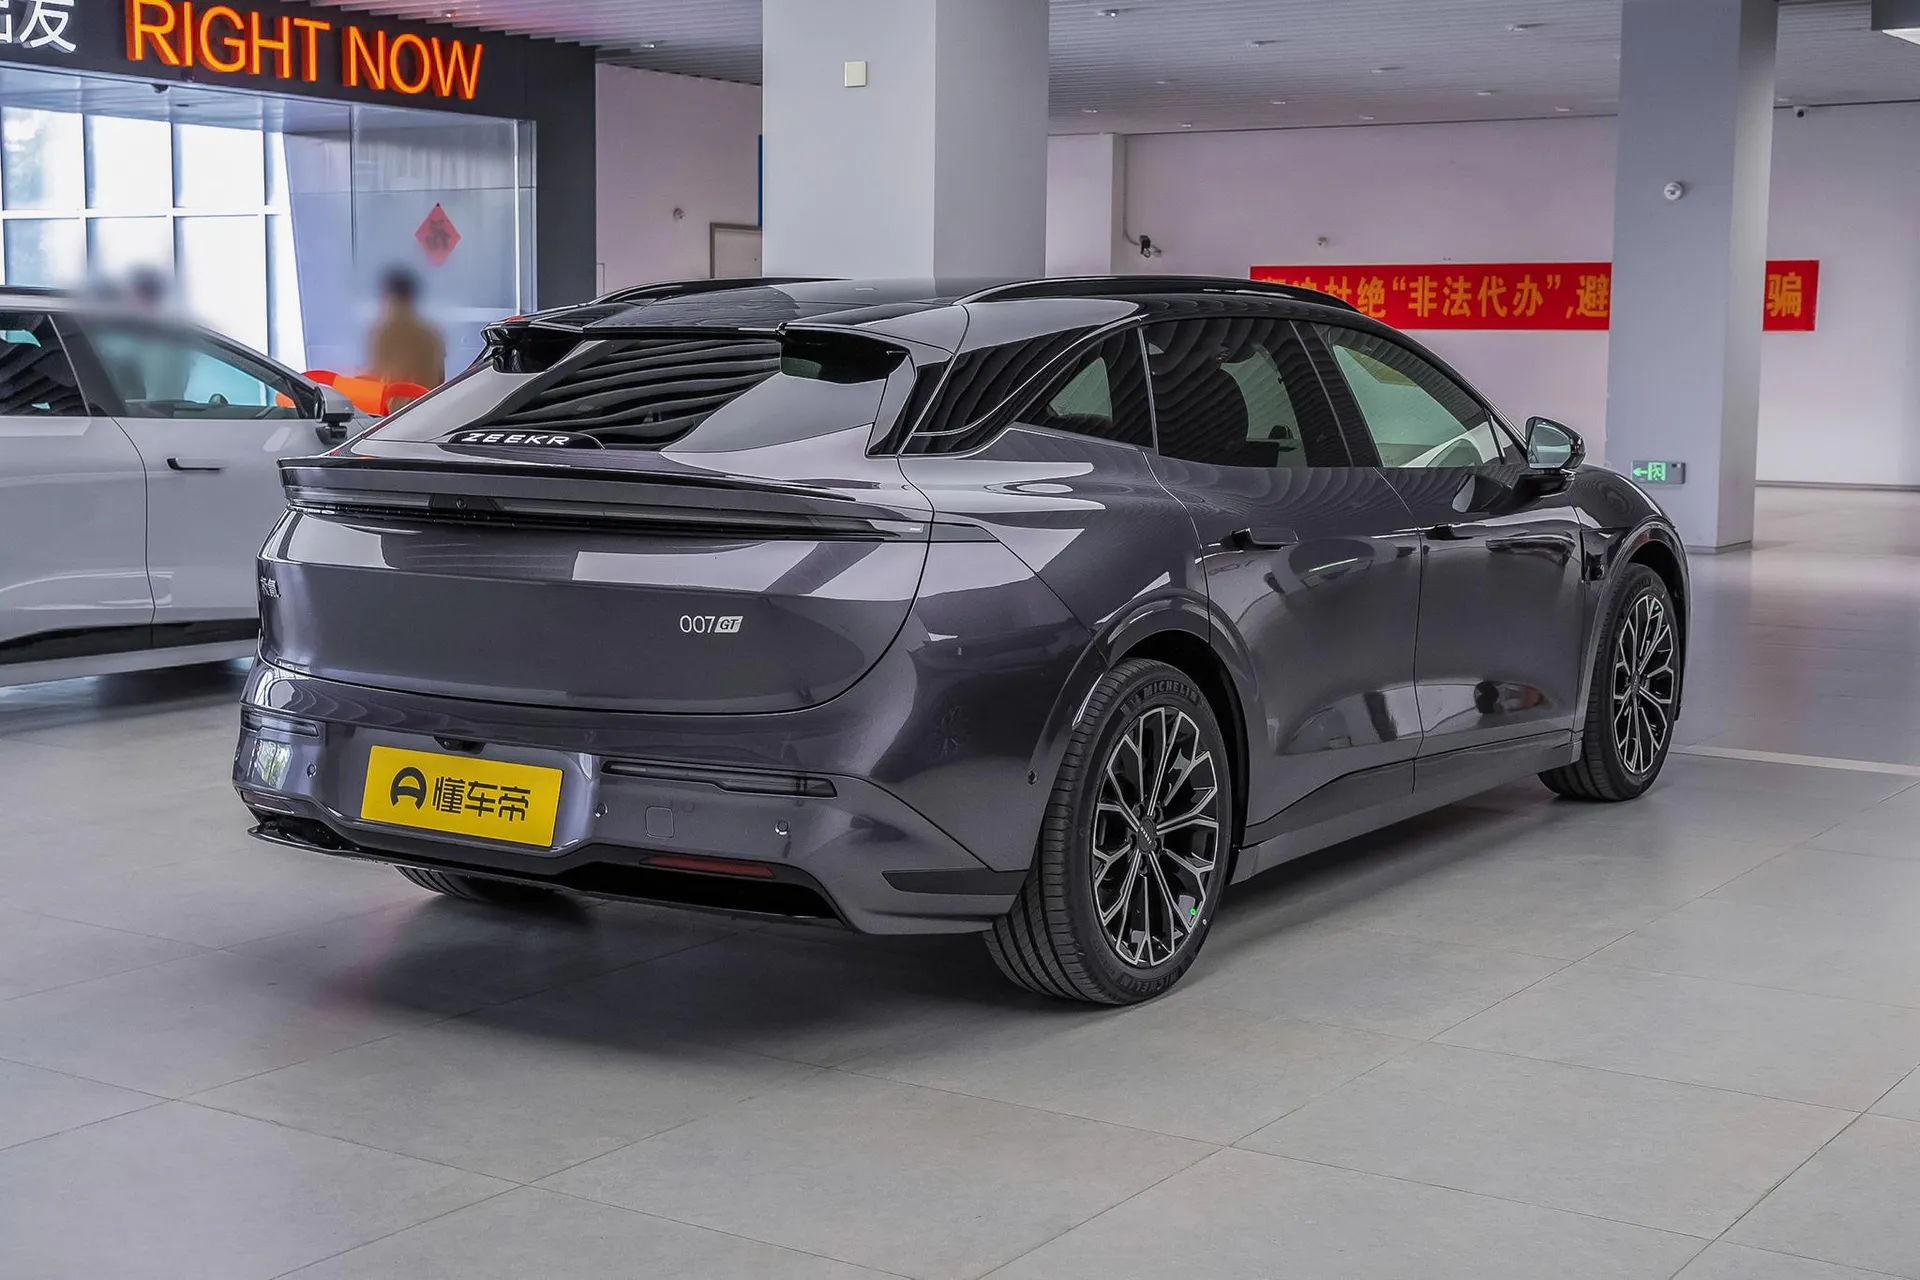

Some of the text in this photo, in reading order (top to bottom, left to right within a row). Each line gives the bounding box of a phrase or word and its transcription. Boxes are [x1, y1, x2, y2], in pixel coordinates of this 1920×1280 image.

[126, 0, 483, 100] RIGHT NOW
[1766, 271, 1802, 318] 骗
[461, 433, 570, 446] ZEEKR
